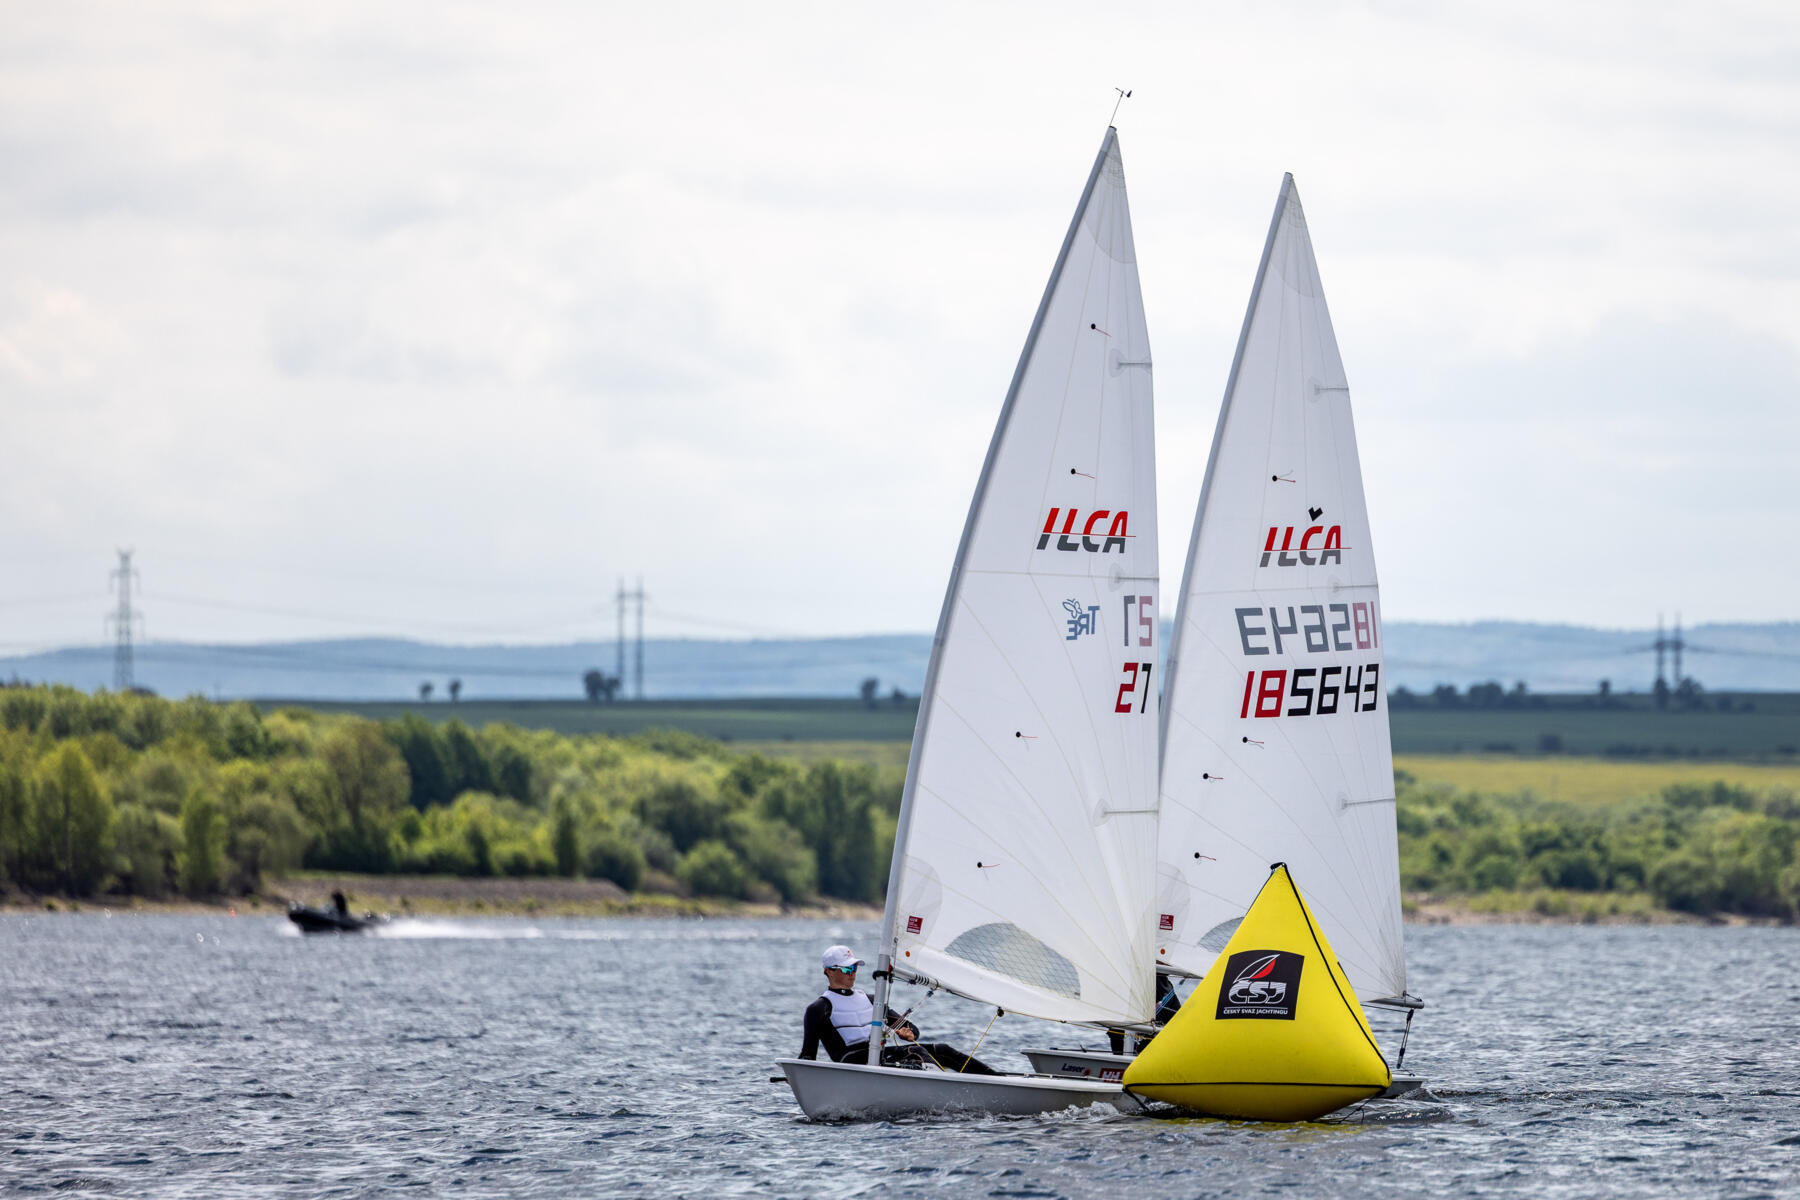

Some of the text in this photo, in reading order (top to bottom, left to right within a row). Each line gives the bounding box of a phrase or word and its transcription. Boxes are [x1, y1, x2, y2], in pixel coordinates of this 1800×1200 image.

[1036, 507, 1128, 554] ILCA
[1114, 662, 1153, 714] 27
[1240, 663, 1380, 719] 185643
[1061, 1063, 1086, 1072] Laser
